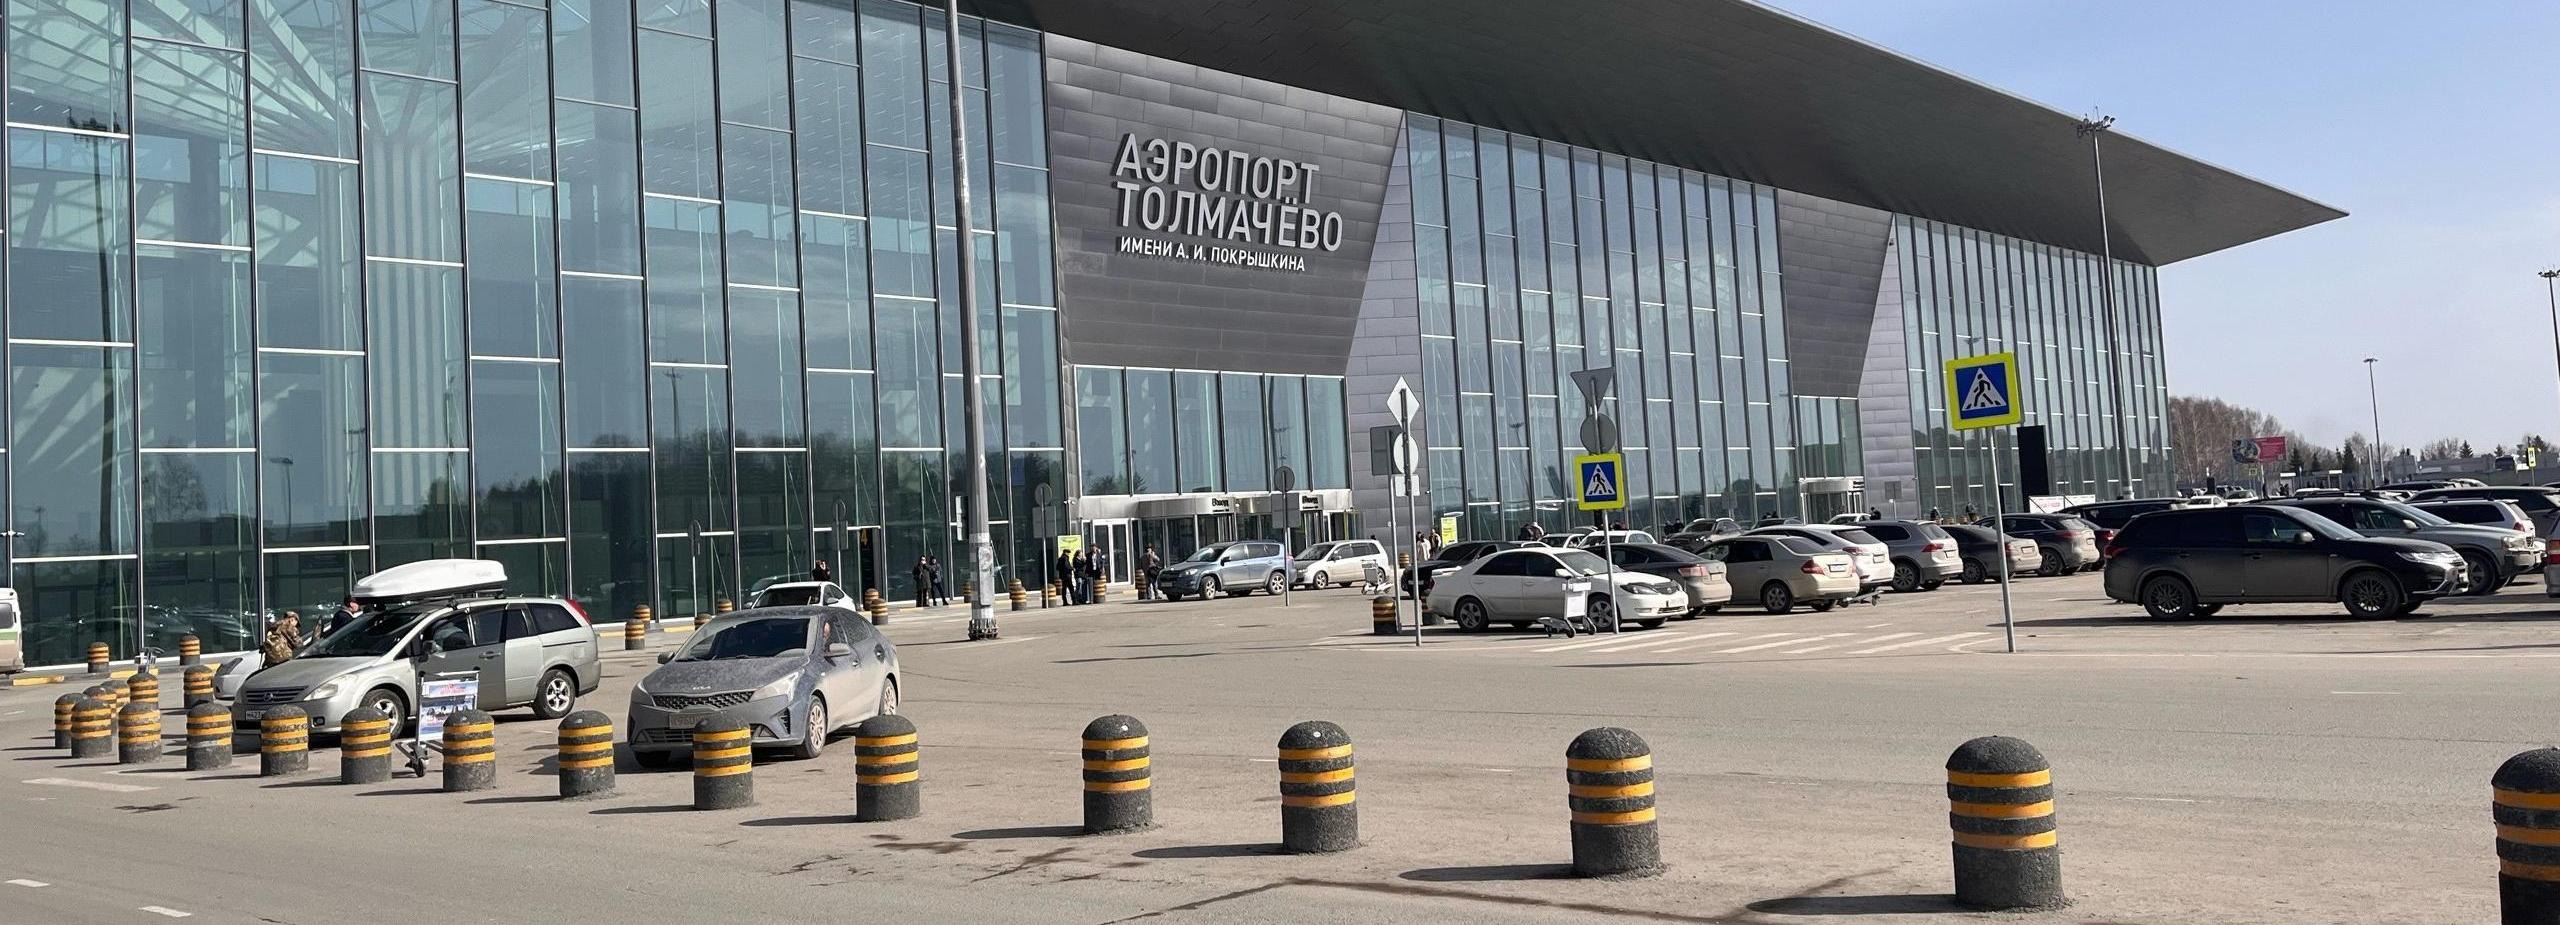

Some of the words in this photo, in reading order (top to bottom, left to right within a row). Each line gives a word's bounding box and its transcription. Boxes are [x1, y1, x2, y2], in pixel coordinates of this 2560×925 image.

[1115, 132, 1320, 204] АЭРОПОРТ
[1116, 181, 1343, 252] ТОЛМАЧЁВО
[1120, 236, 1174, 257] ИМЕНИ
[1176, 245, 1190, 260] А.
[1193, 245, 1207, 261] И.
[1211, 246, 1305, 272] ПОКРЫШКИНА
